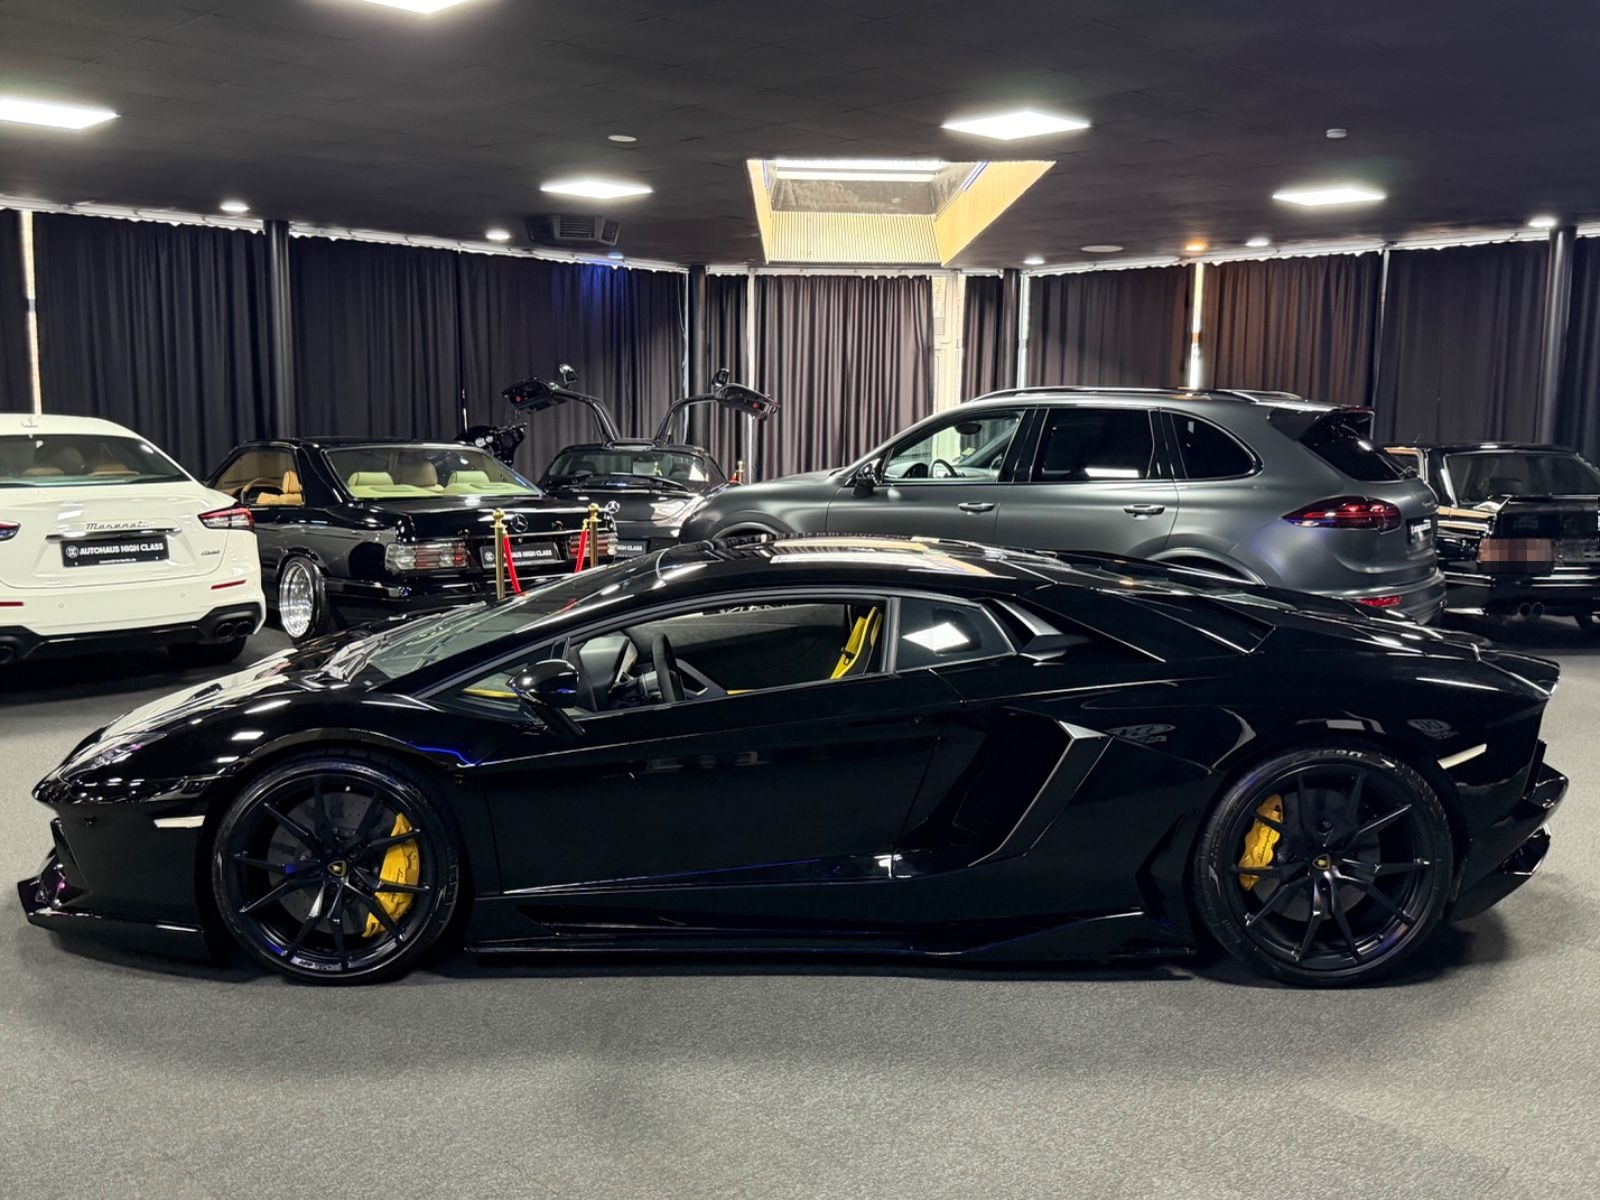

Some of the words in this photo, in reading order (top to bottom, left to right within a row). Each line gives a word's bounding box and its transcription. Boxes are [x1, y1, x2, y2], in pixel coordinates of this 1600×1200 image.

[80, 545, 120, 556] AUTOHAUS
[120, 544, 139, 553] HIGH
[140, 542, 164, 551] CLASS
